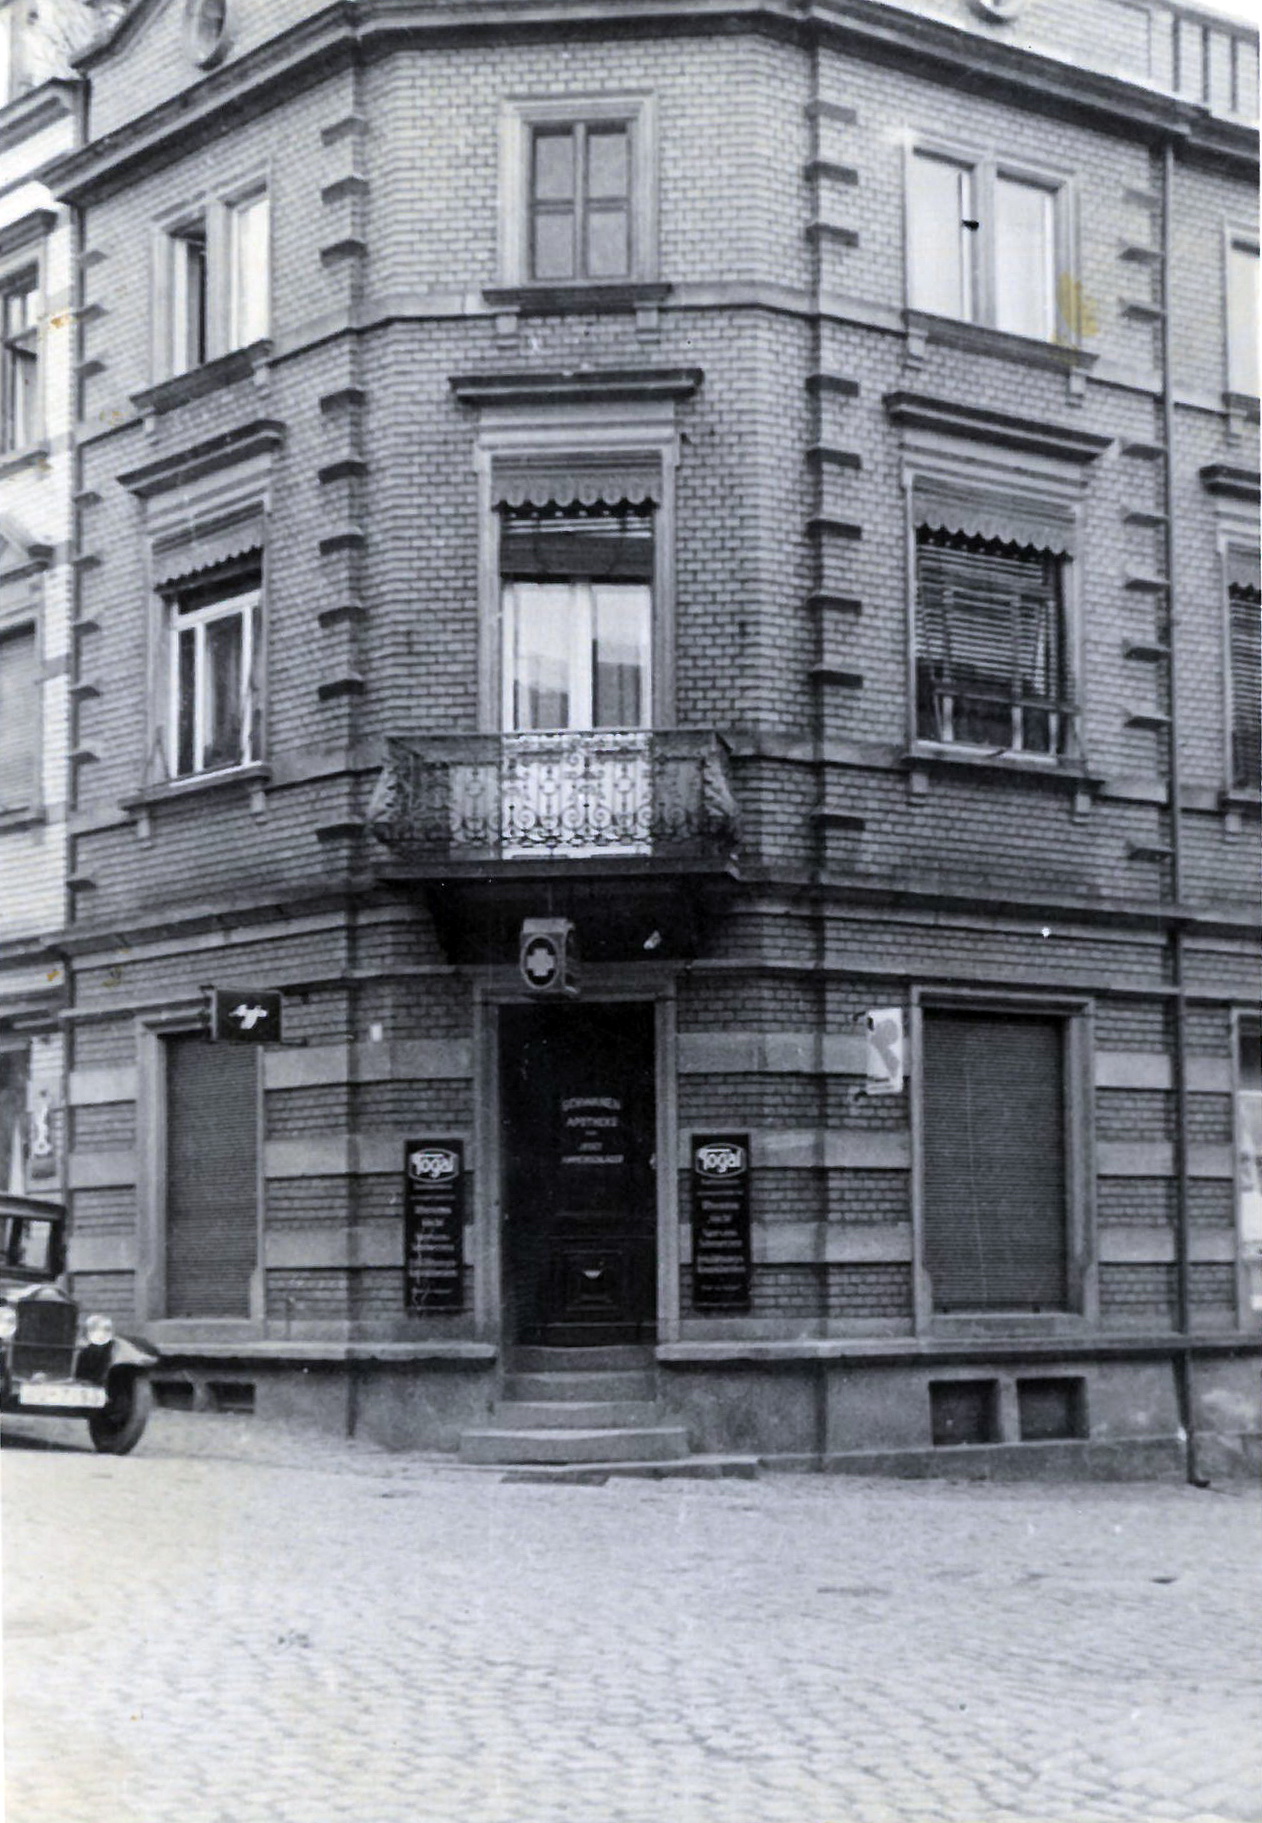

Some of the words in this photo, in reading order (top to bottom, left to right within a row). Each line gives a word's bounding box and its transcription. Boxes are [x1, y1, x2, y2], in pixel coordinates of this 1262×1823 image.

[566, 1116, 619, 1128] APOTHEKE
[411, 1153, 454, 1178] Togal
[698, 1148, 741, 1173] Togal
